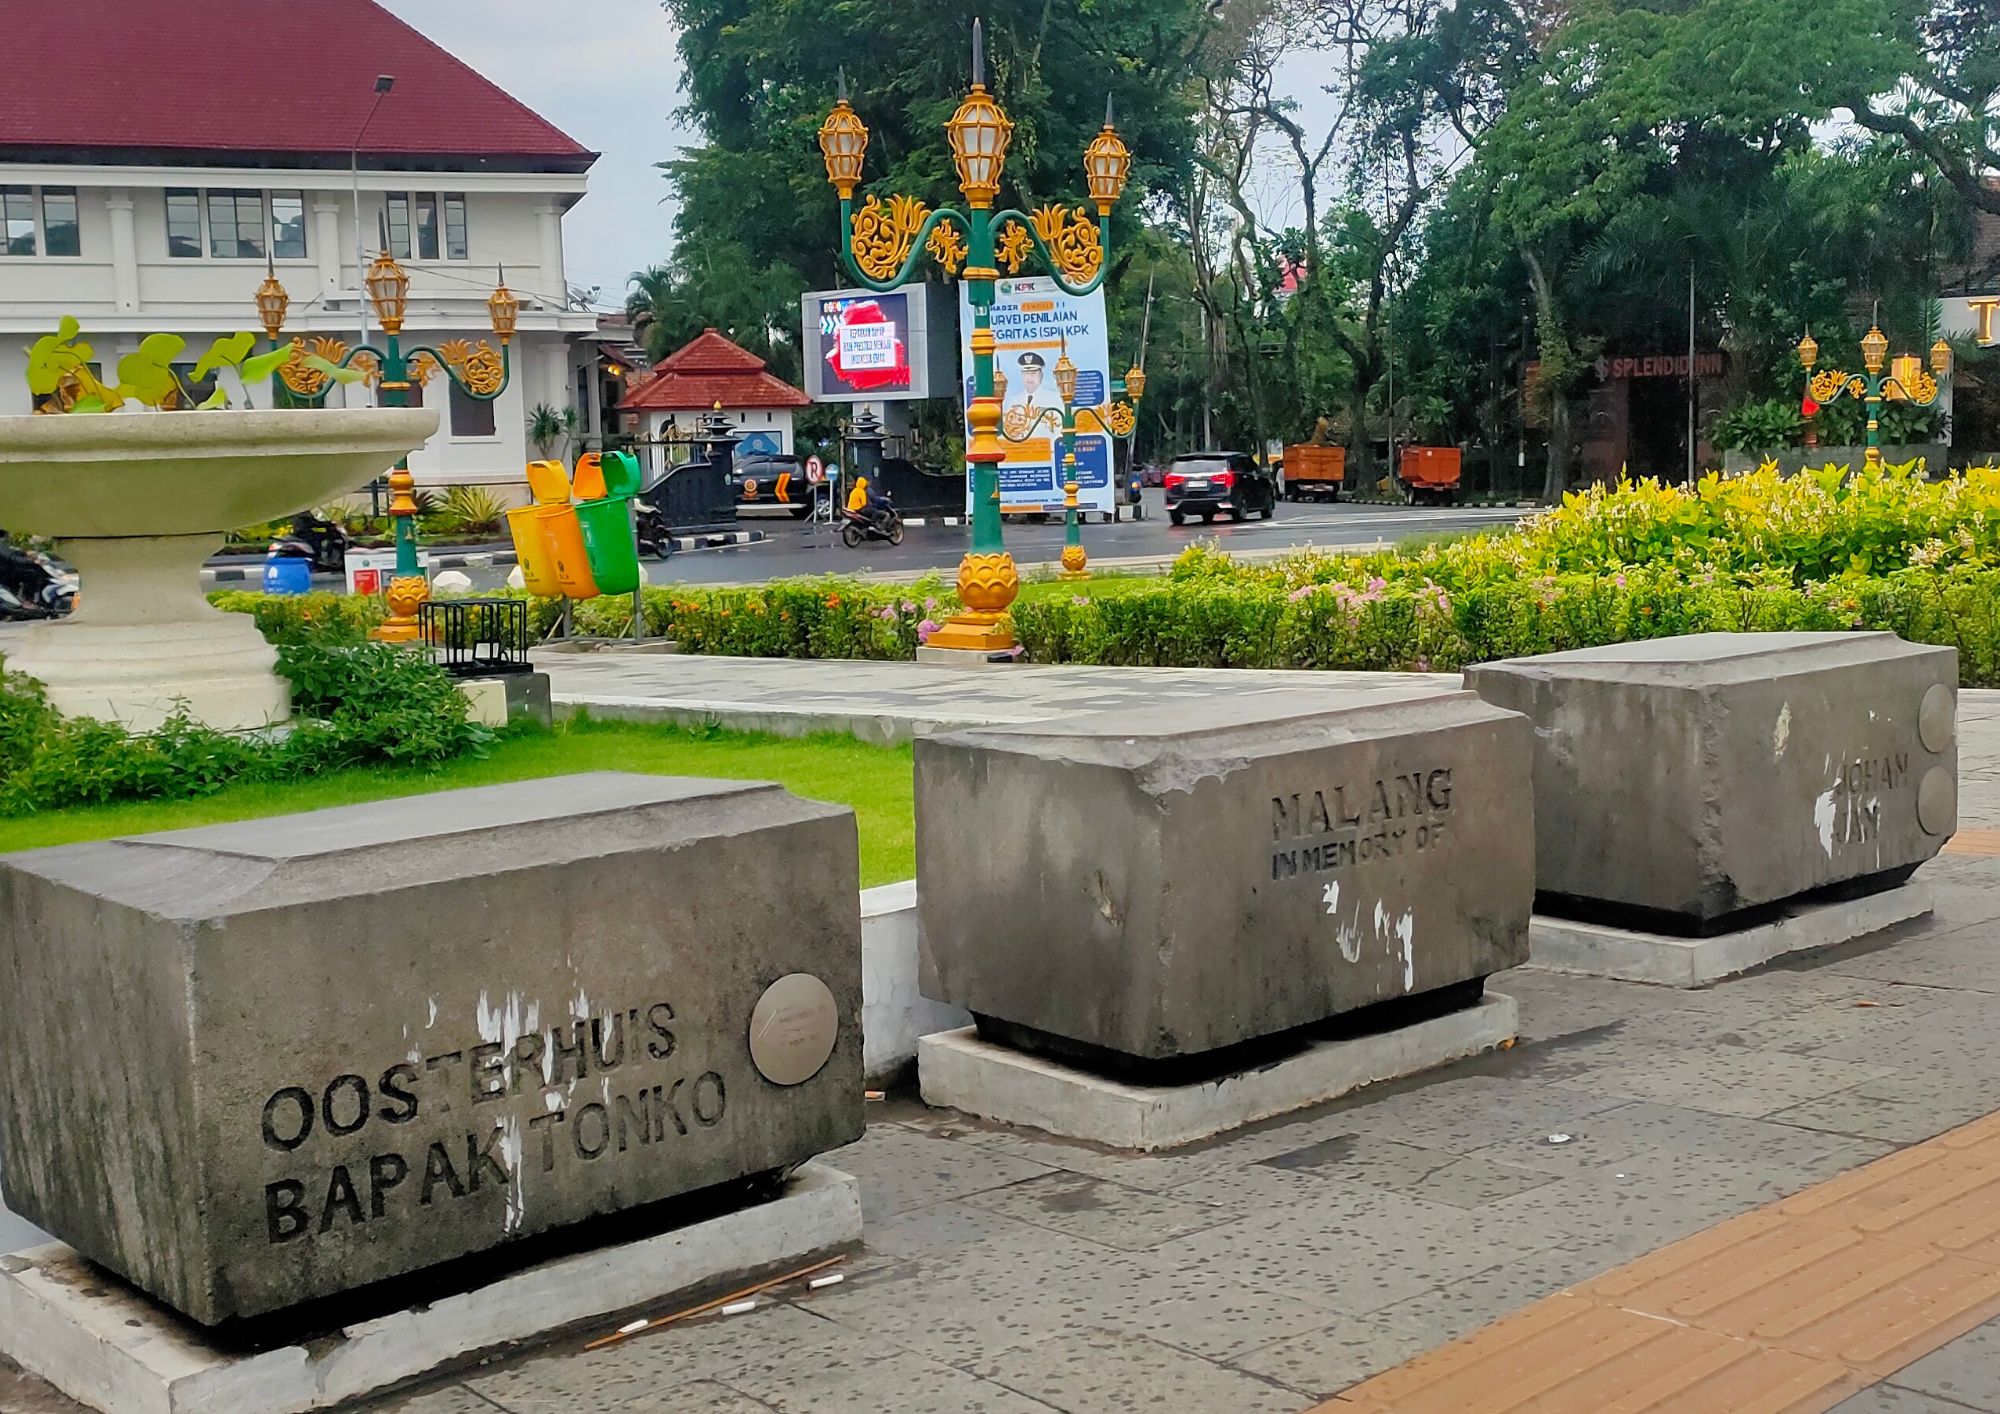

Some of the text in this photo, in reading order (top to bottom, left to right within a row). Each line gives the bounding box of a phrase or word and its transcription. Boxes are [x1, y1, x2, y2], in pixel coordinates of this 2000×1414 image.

[1014, 282, 1036, 292] KPK
[990, 311, 1078, 326] URVEI PENILAIAN
[1065, 325, 1090, 337] KPK
[1613, 353, 1722, 378] SPLENDID INN
[1832, 753, 1909, 794] JOHAN
[1271, 767, 1453, 841] MALANG
[1271, 821, 1446, 881] IN MEMORY OF
[260, 1002, 677, 1153] OOSTERHUIS
[264, 1070, 727, 1245] BAPAK TONKO
